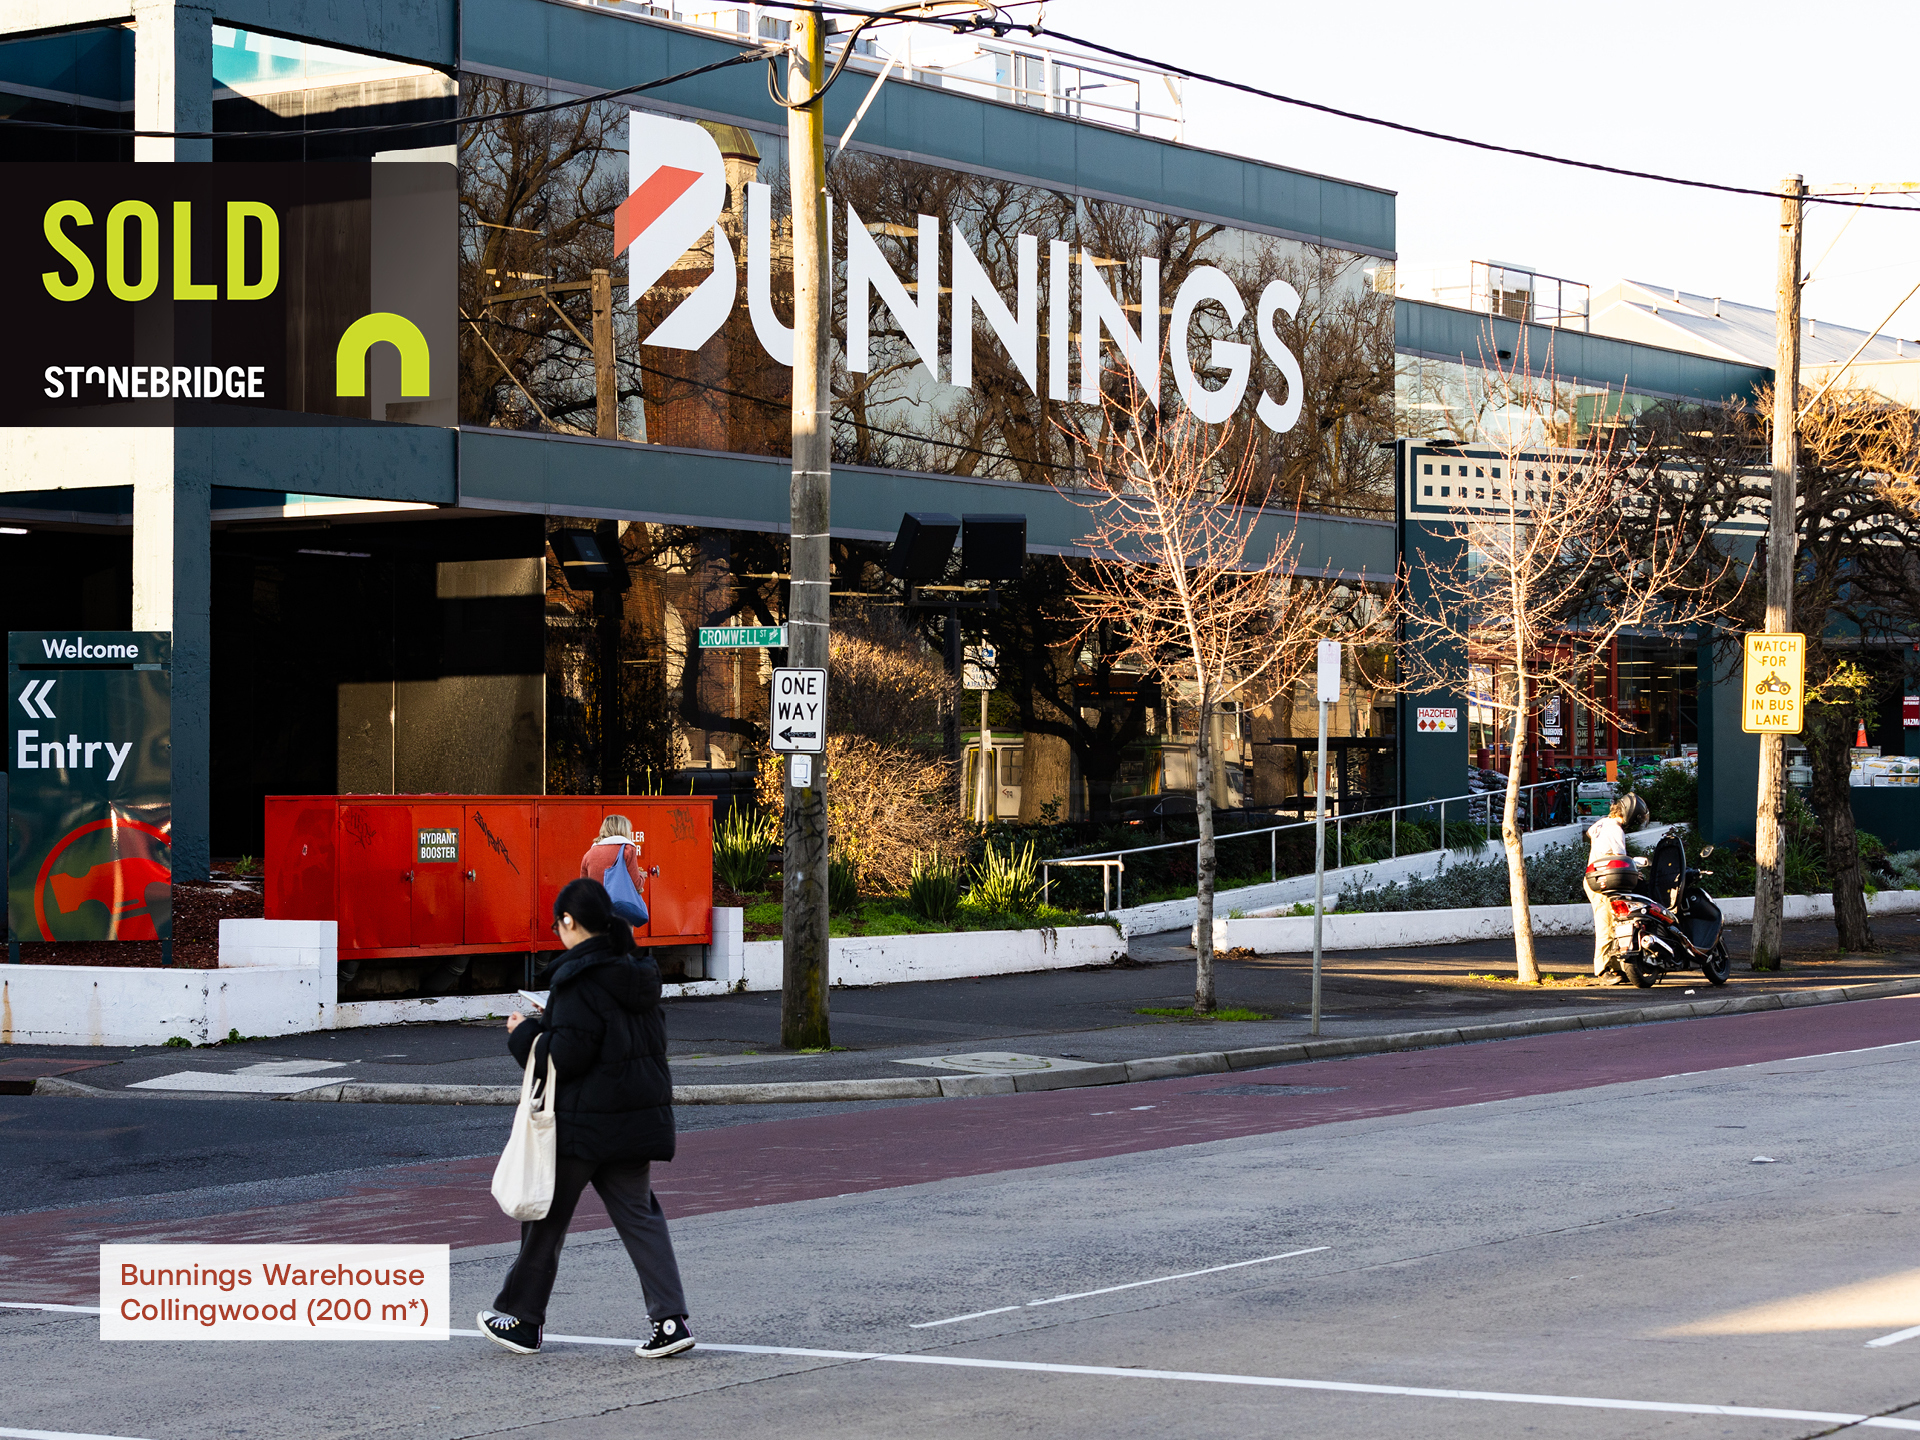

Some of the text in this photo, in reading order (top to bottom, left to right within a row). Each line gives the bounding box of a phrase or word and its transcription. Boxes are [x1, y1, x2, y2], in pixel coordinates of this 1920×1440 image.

[614, 111, 1304, 434] BUNNINGS
[700, 629, 760, 646] CROMWELL
[760, 629, 767, 638] ST
[42, 637, 139, 659] Welcome
[1753, 640, 1796, 652] WATCH
[1762, 656, 1787, 667] FOR
[781, 673, 817, 695] ONE
[1751, 699, 1794, 711] IN BUS
[778, 703, 818, 721] WAY
[1418, 709, 1456, 718] HAZCHEM
[1756, 714, 1789, 726] LANE
[18, 730, 133, 781] Entry
[420, 832, 457, 845] HYDRANT
[421, 847, 456, 859] BOOSTER
